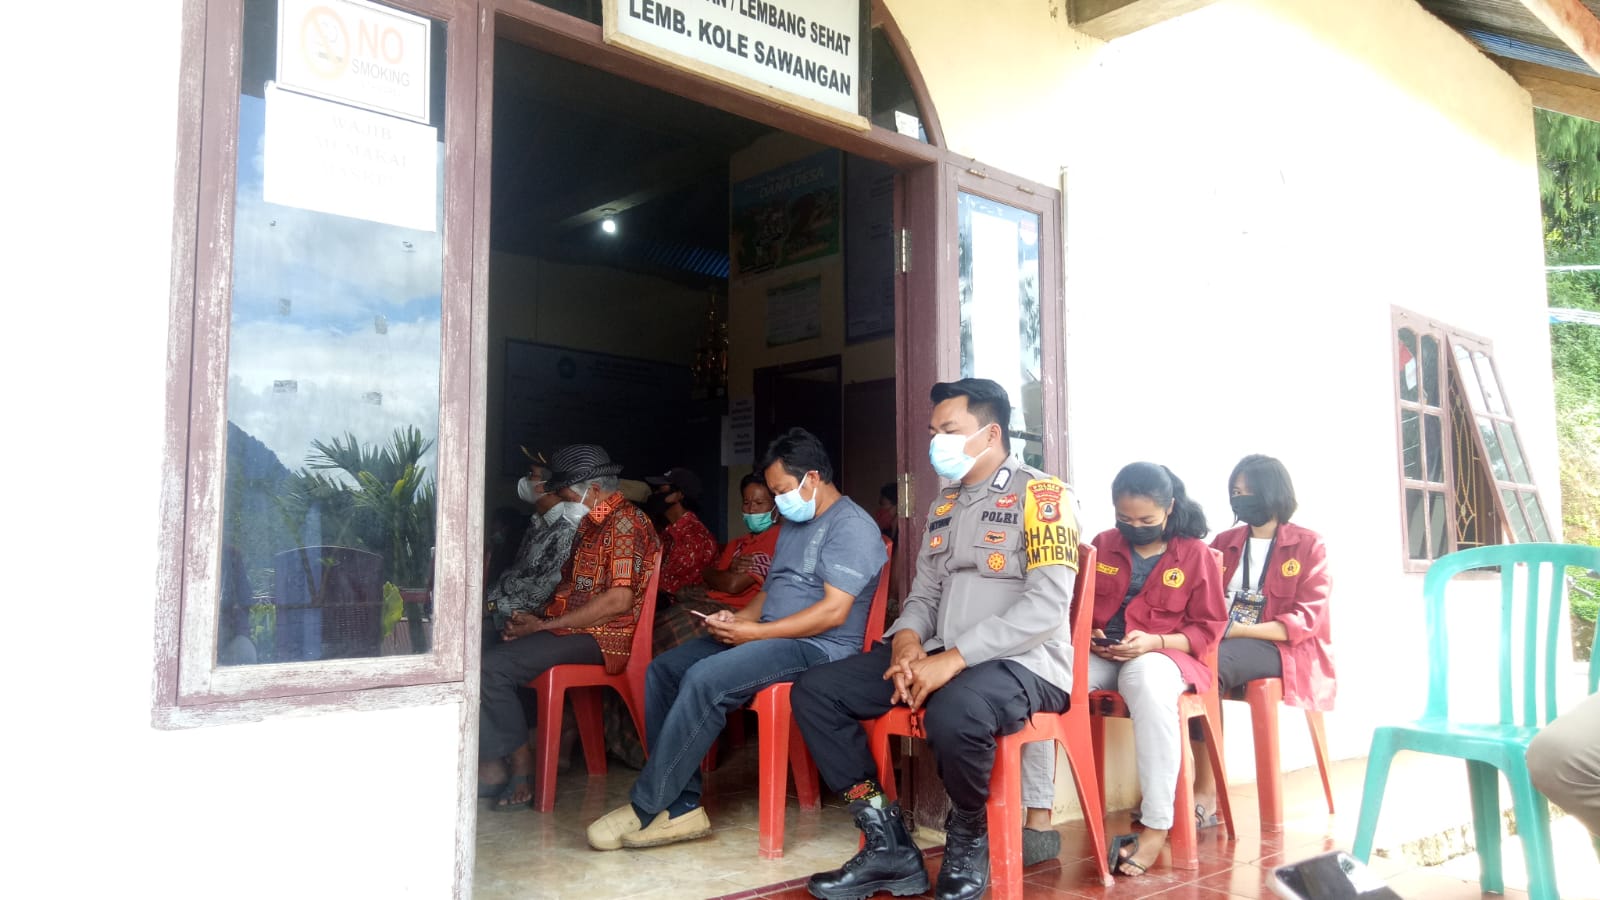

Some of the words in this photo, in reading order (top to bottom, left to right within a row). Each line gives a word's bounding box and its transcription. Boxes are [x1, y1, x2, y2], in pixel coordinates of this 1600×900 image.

[358, 18, 405, 65] NO
[739, 0, 806, 38] LEMBANG
[810, 21, 851, 56] SEHAT
[629, 0, 692, 37] LEMB.
[698, 18, 749, 59] KOLE
[754, 41, 851, 96] SAWANGAN
[351, 58, 411, 87] SMOKING
[331, 113, 392, 140] WAJIB
[981, 510, 1019, 525] POLRI
[1026, 545, 1079, 567] AMTIBMA
